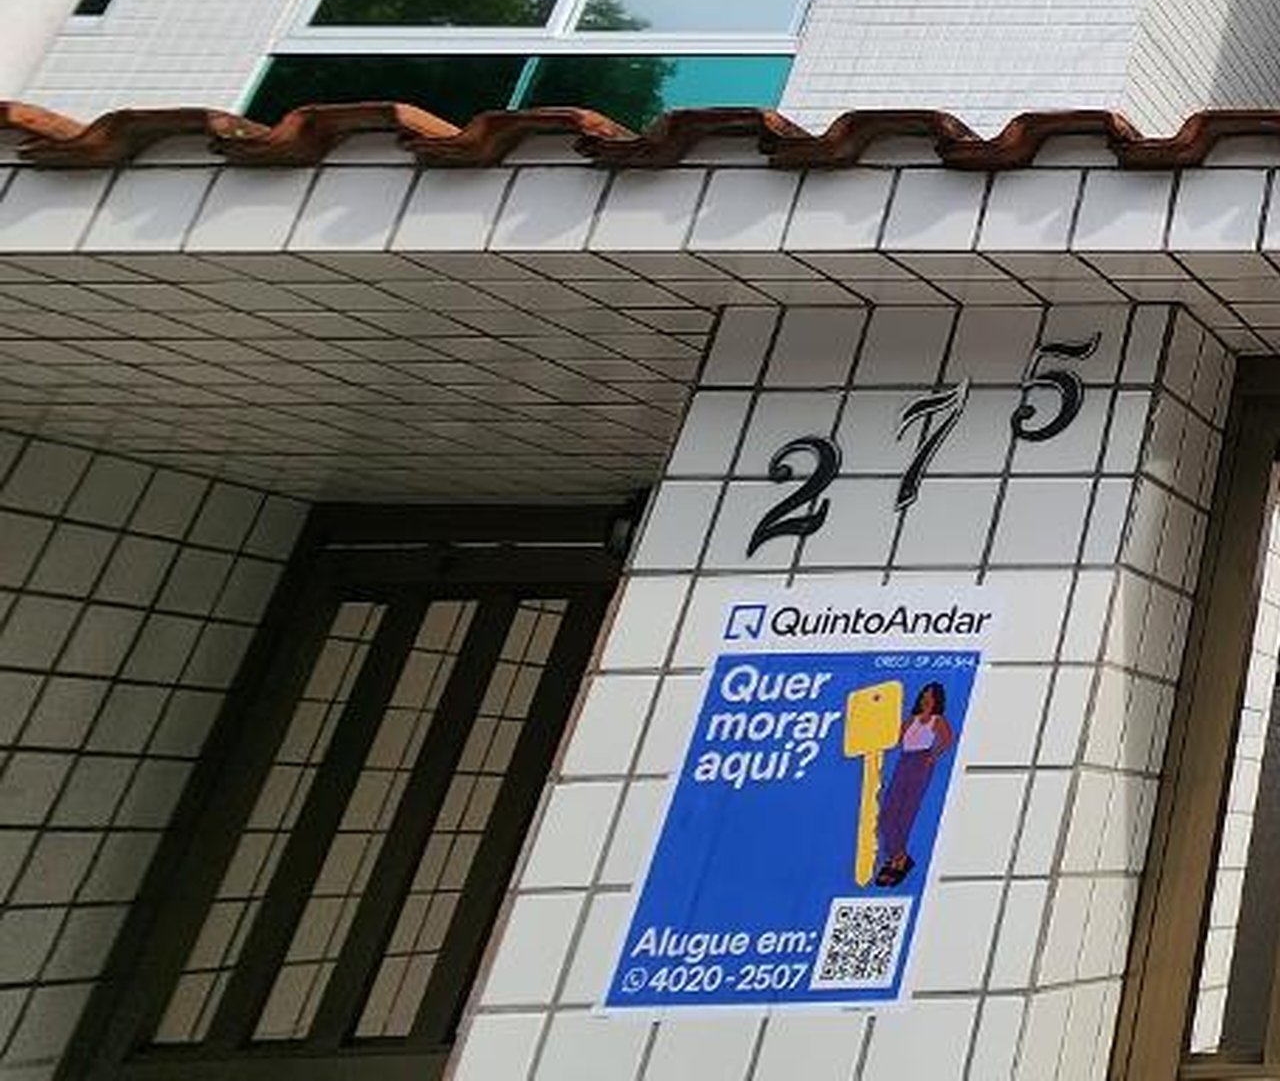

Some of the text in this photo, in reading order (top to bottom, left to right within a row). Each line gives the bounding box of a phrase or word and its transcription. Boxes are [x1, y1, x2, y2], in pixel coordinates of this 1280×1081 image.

[746, 332, 1102, 559] 275
[770, 604, 992, 637] QuintoAndar
[721, 665, 832, 703] Quer
[706, 711, 842, 741] morar
[694, 740, 820, 790] aqui?
[631, 927, 818, 964] Alugue em:
